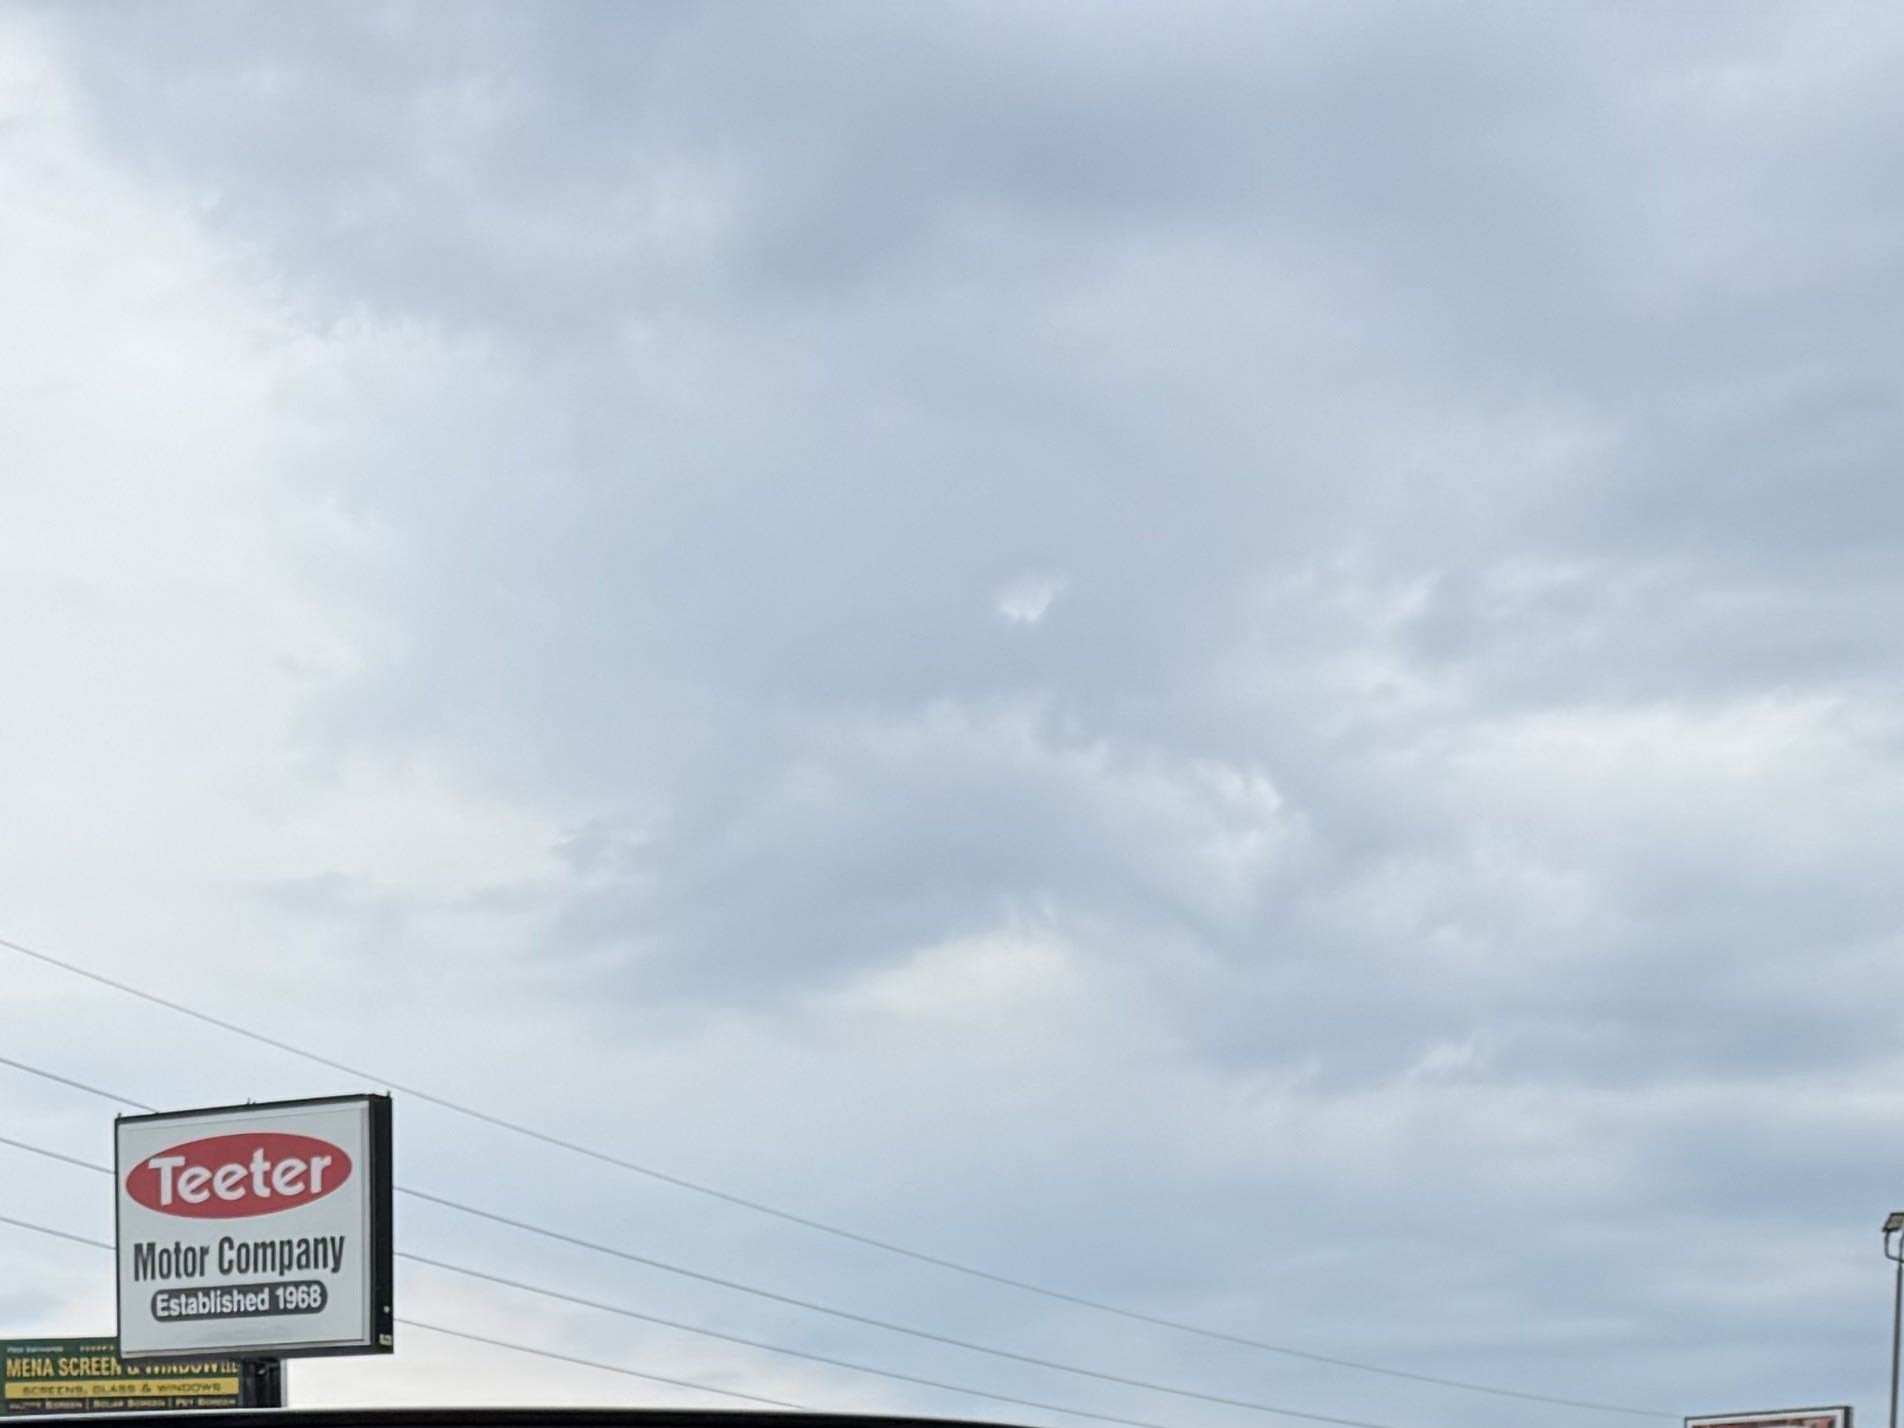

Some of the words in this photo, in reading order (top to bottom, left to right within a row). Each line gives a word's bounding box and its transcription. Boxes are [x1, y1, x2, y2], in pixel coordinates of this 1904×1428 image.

[148, 1148, 332, 1206] Teeter
[133, 1241, 210, 1281] Motor
[218, 1235, 345, 1277] Company
[156, 1287, 270, 1317] Established
[276, 1284, 322, 1309] 1968
[6, 1357, 54, 1377] MENA
[58, 1355, 122, 1377] SCREEN
